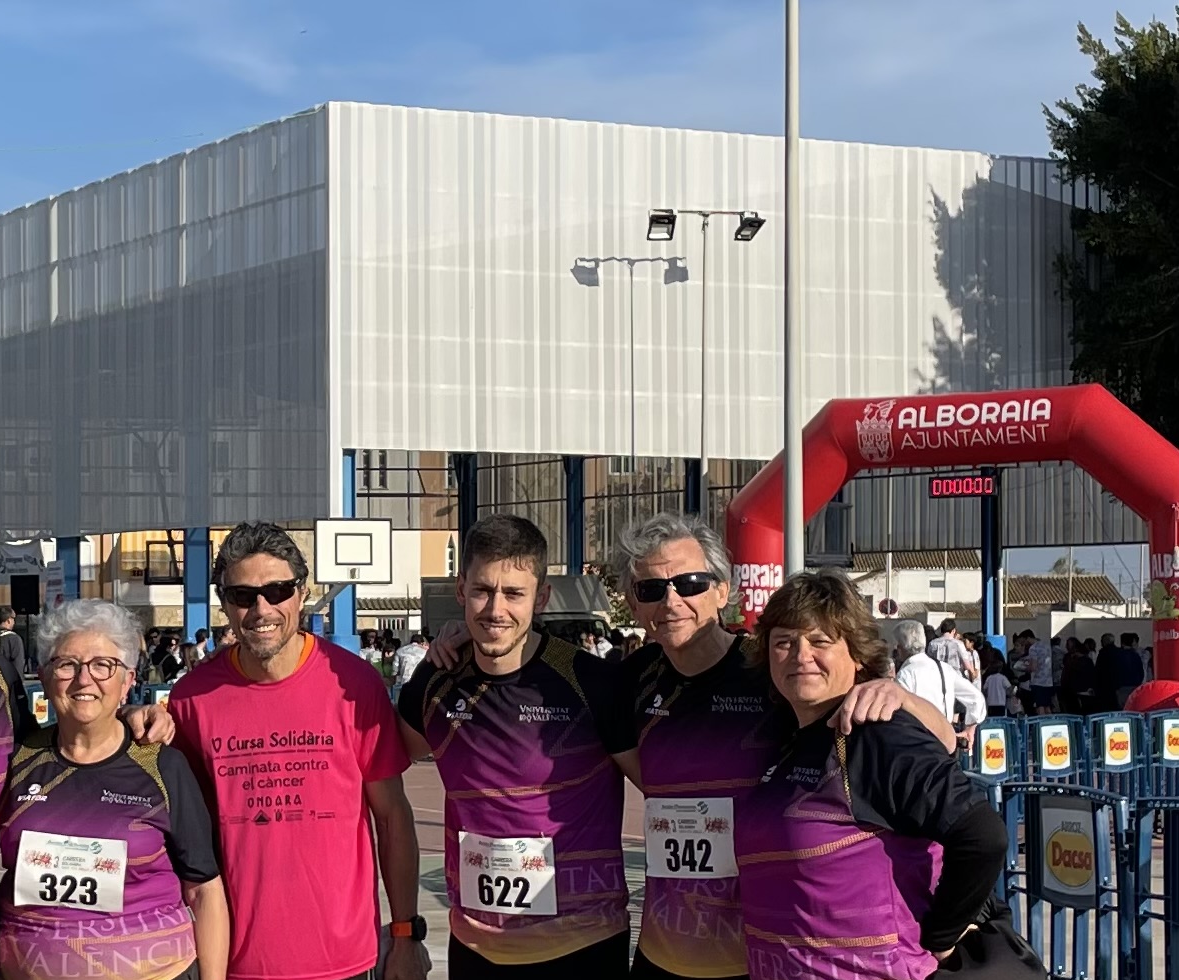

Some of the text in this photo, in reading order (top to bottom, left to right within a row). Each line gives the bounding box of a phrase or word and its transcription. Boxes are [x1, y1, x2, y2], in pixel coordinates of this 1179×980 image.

[898, 398, 1051, 430] ALBORAIA
[901, 423, 1050, 450] AJUNTAMENT
[227, 735, 264, 750] Cursa
[269, 729, 334, 747] Solidària
[217, 759, 329, 777] Caminata contra
[242, 776, 305, 791] el càncer
[664, 838, 714, 873] 342
[1051, 840, 1092, 871] Dacsa
[38, 873, 98, 905] 323
[477, 873, 532, 909] 622
